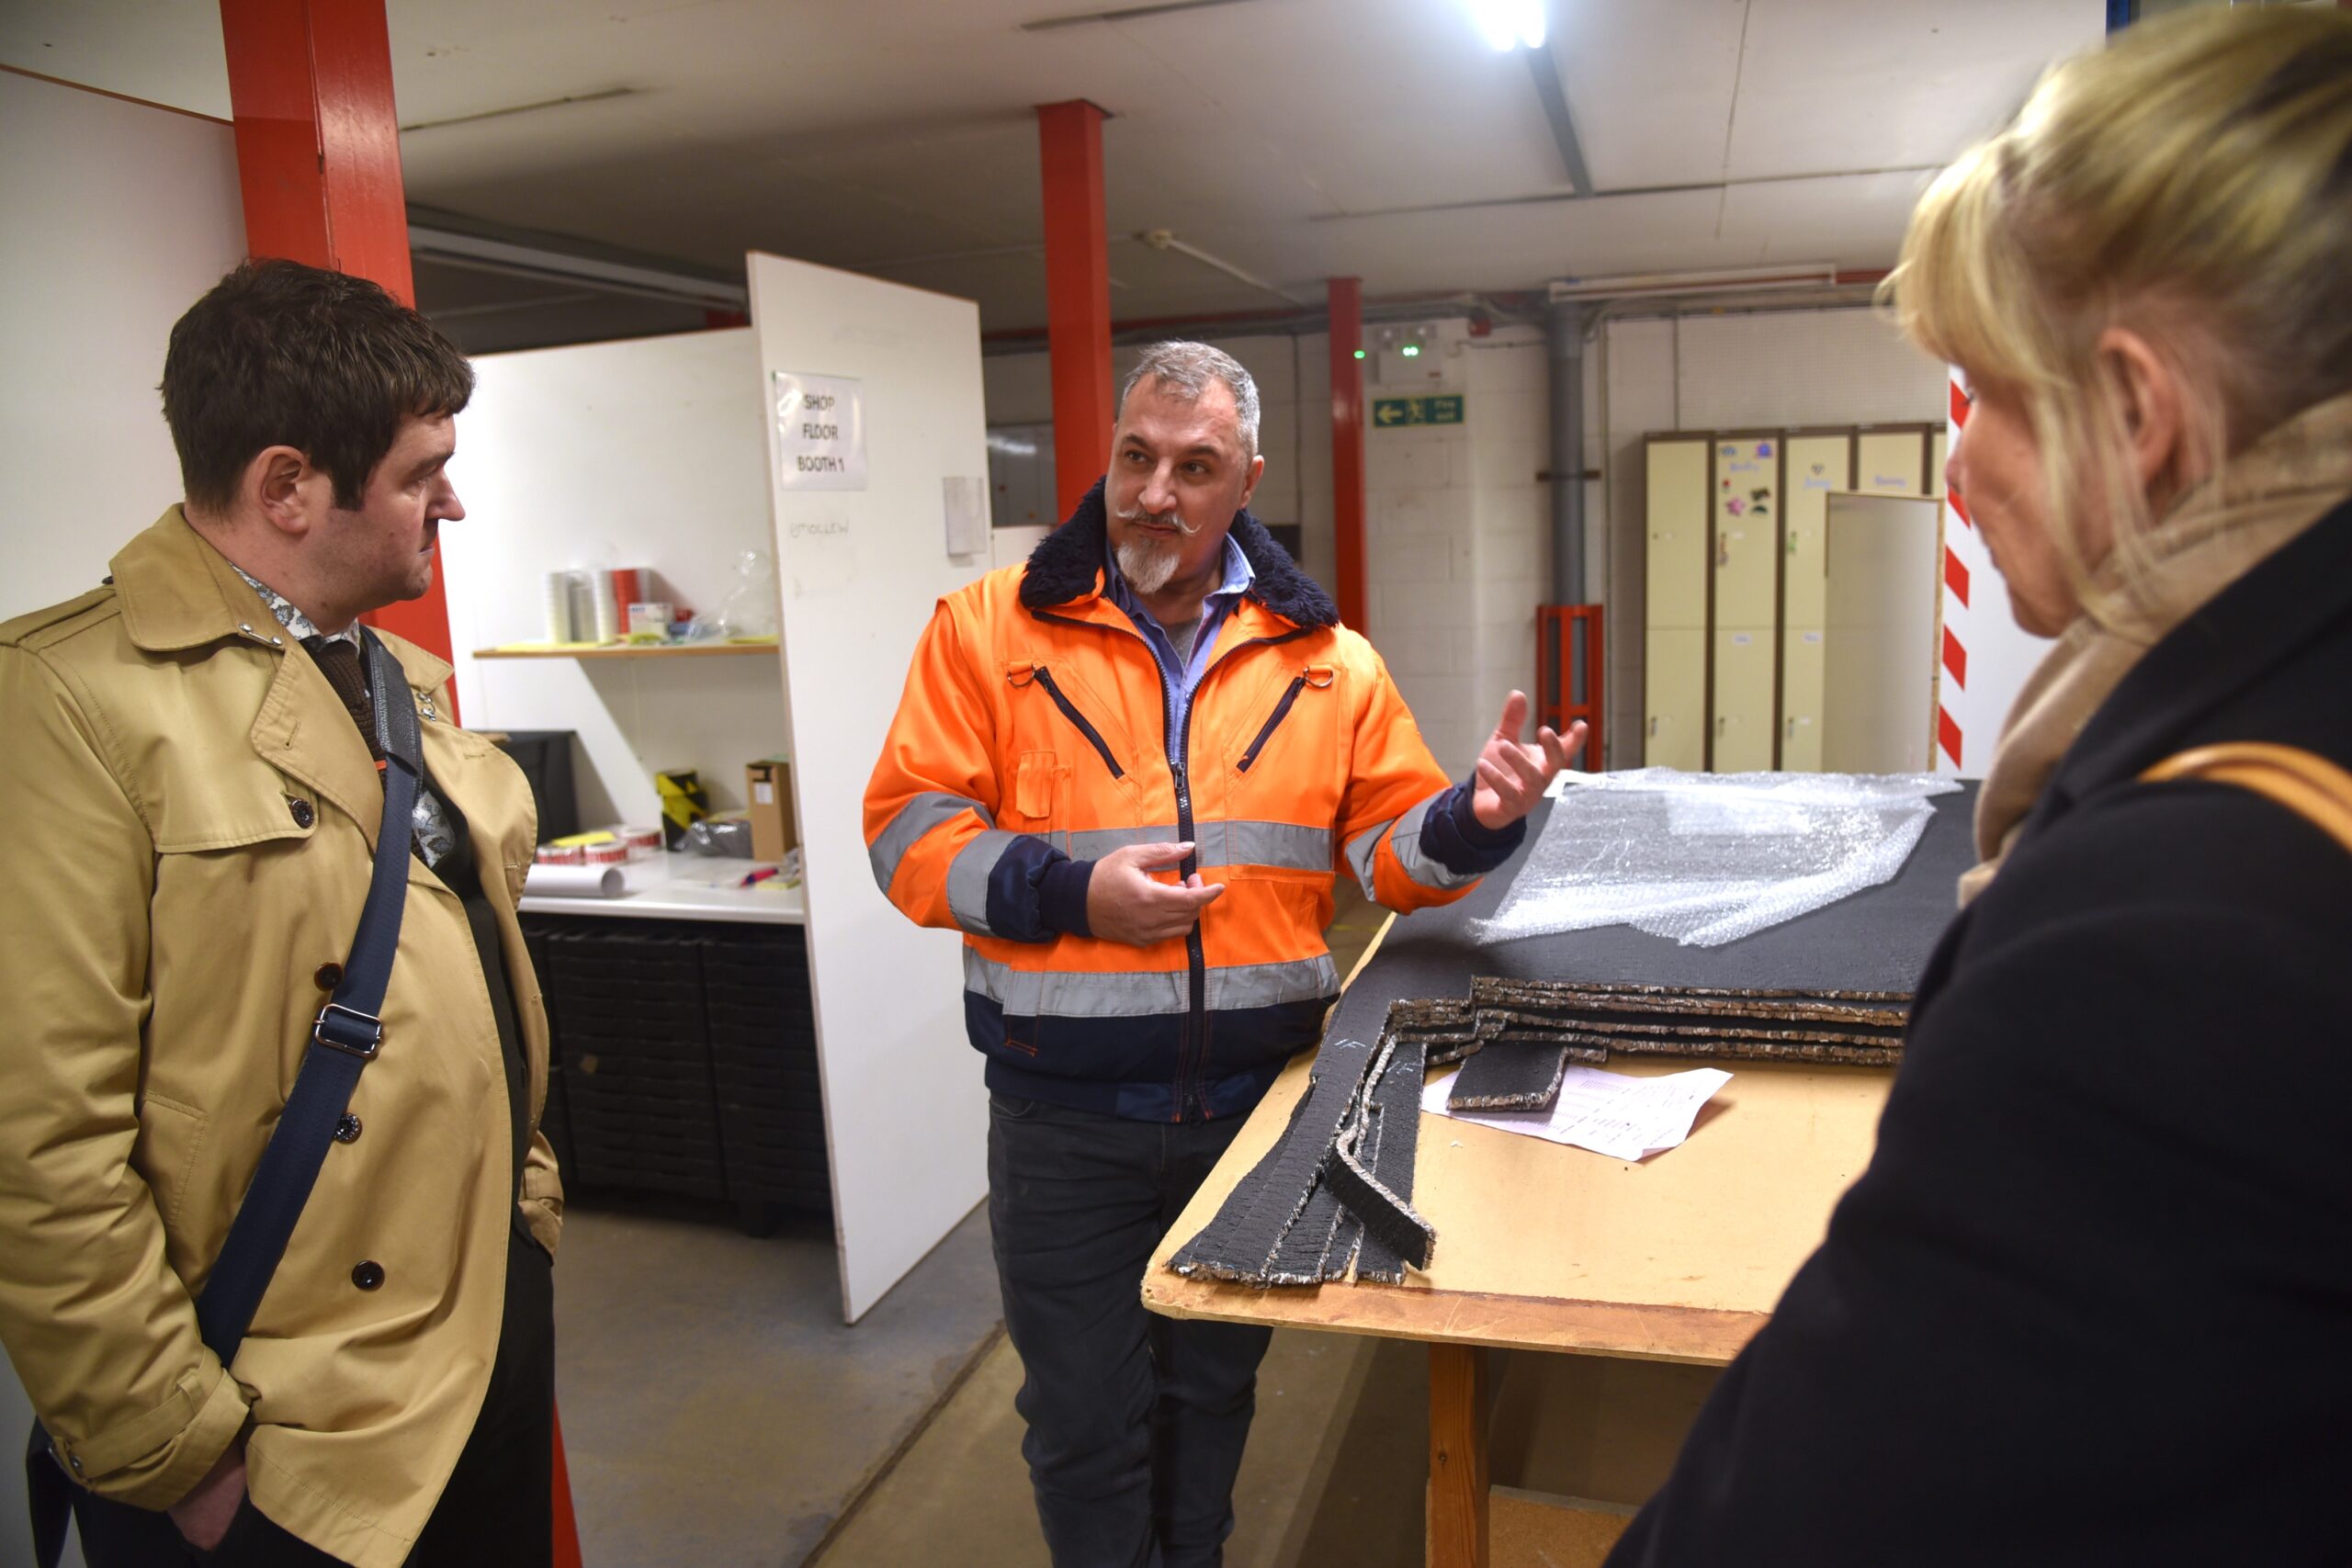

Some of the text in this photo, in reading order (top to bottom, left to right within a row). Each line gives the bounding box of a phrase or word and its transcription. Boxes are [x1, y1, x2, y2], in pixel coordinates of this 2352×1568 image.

[804, 394, 836, 412] SHOP
[803, 423, 838, 441] FLOOR
[797, 456, 845, 473] BOOTH 1
